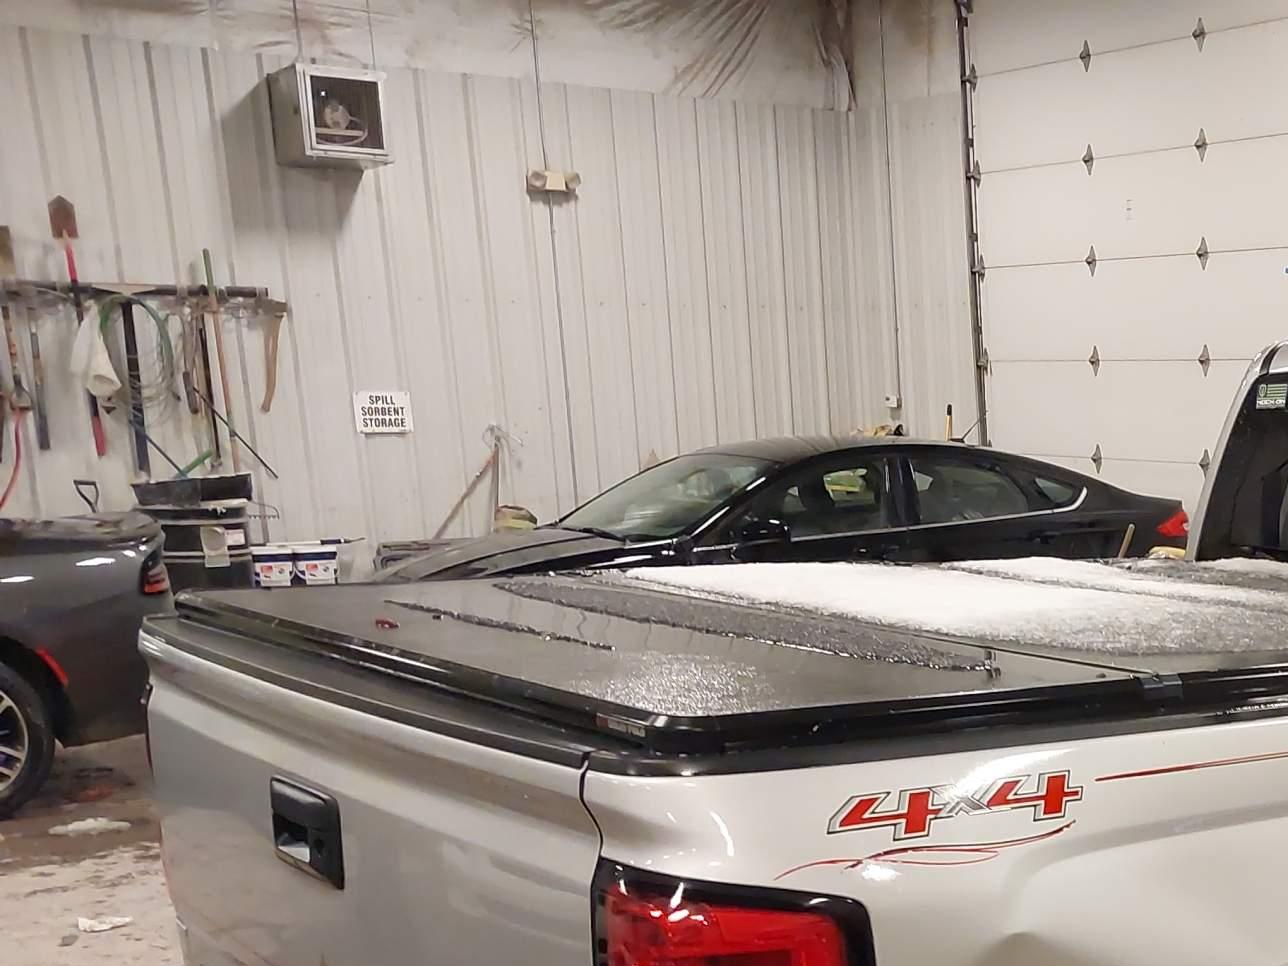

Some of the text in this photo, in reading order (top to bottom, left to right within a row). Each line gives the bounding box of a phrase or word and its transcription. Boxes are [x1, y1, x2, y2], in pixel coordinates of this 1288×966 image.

[368, 395, 396, 405] SPILL
[361, 406, 405, 416] SORBENT
[362, 417, 407, 428] STORAGE
